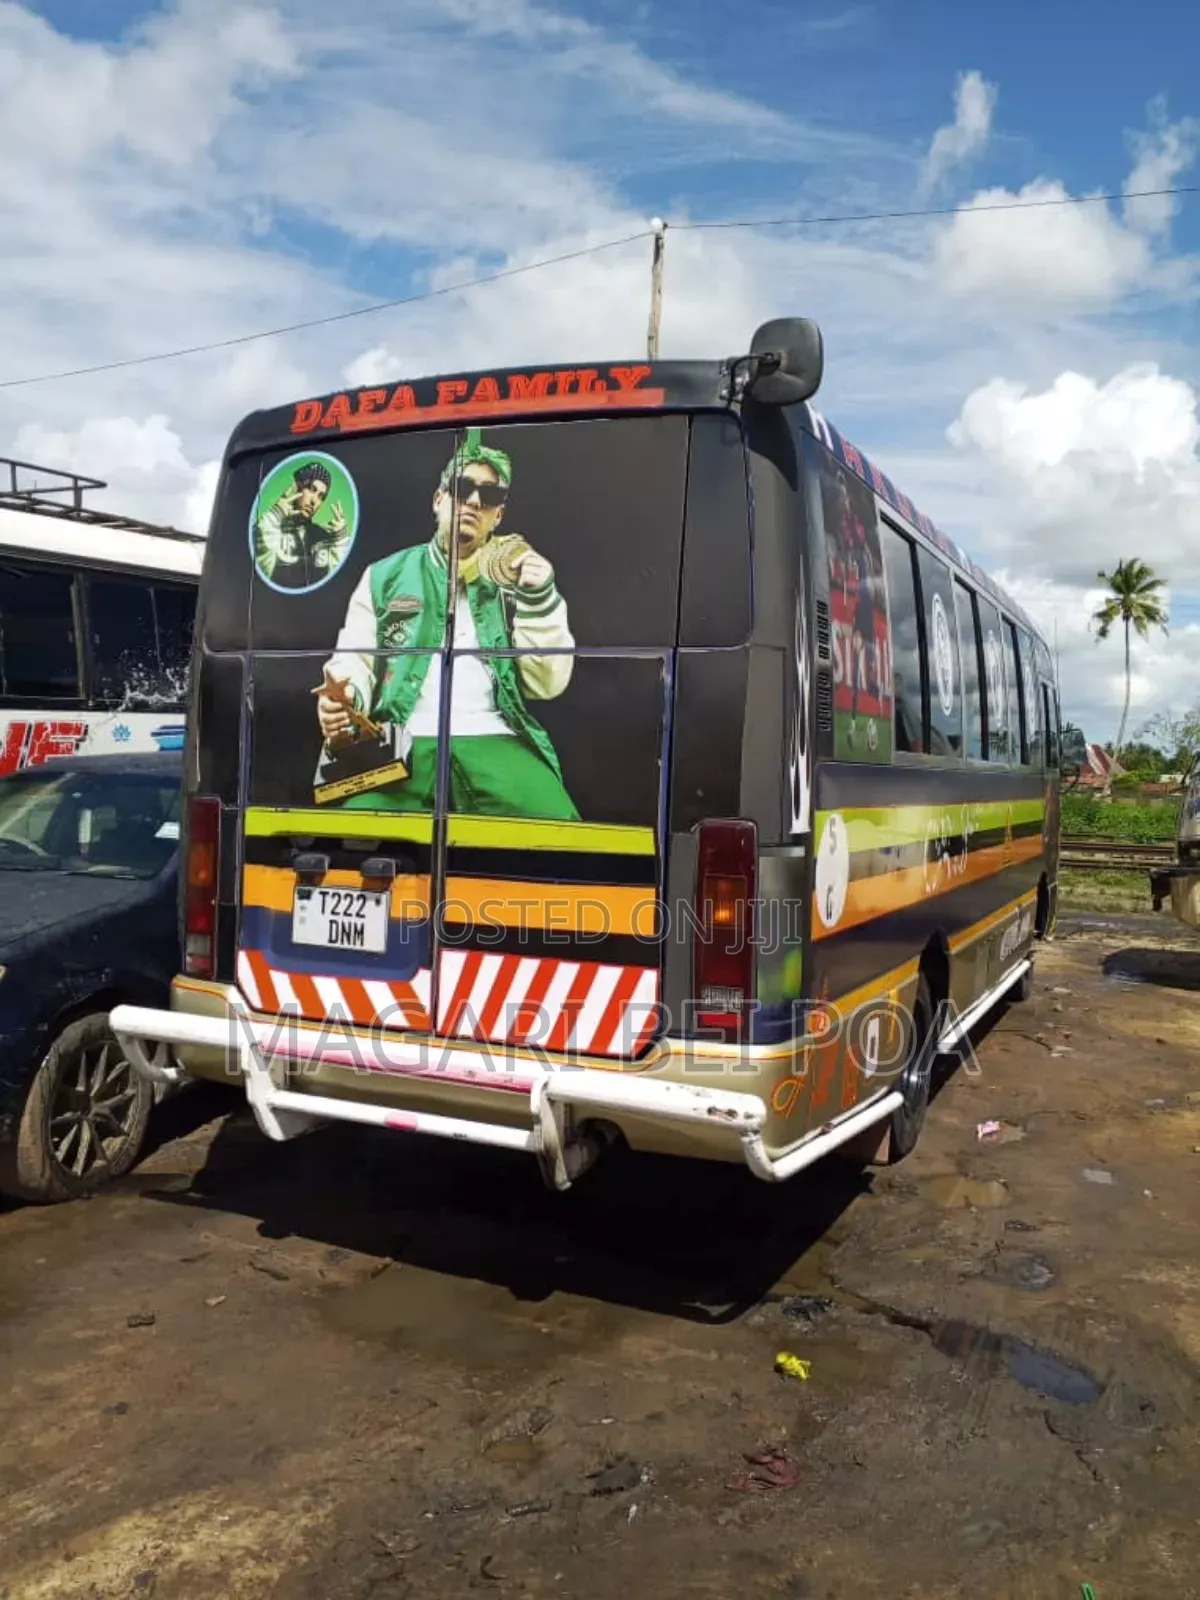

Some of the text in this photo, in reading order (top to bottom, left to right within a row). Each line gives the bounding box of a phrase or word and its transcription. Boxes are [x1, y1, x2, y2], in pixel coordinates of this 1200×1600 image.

[435, 365, 651, 407] FAMILY
[319, 891, 367, 918] T222
[328, 919, 364, 946] DNM
